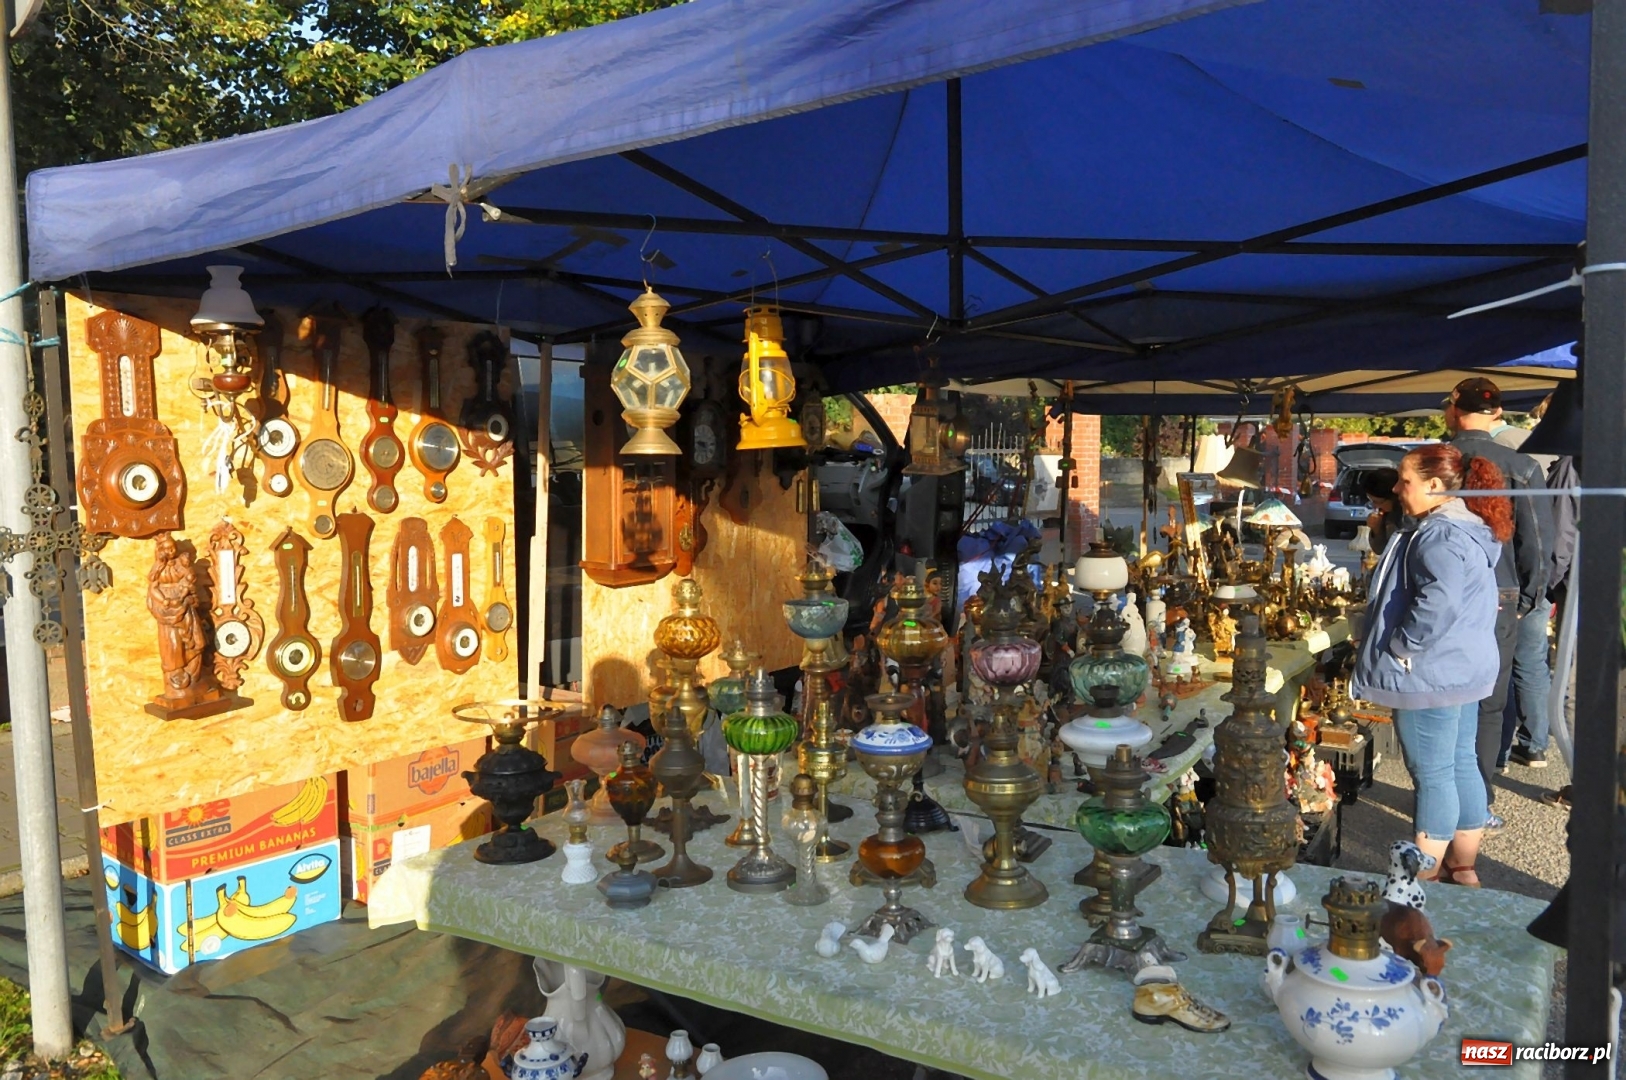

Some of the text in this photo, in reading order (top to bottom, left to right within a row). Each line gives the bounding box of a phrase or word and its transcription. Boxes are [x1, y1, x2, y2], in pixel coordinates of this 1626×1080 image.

[411, 756, 456, 783] bajella
[168, 825, 230, 846] CLASS EXTRA
[191, 827, 316, 868] PREMIUM BANANAS
